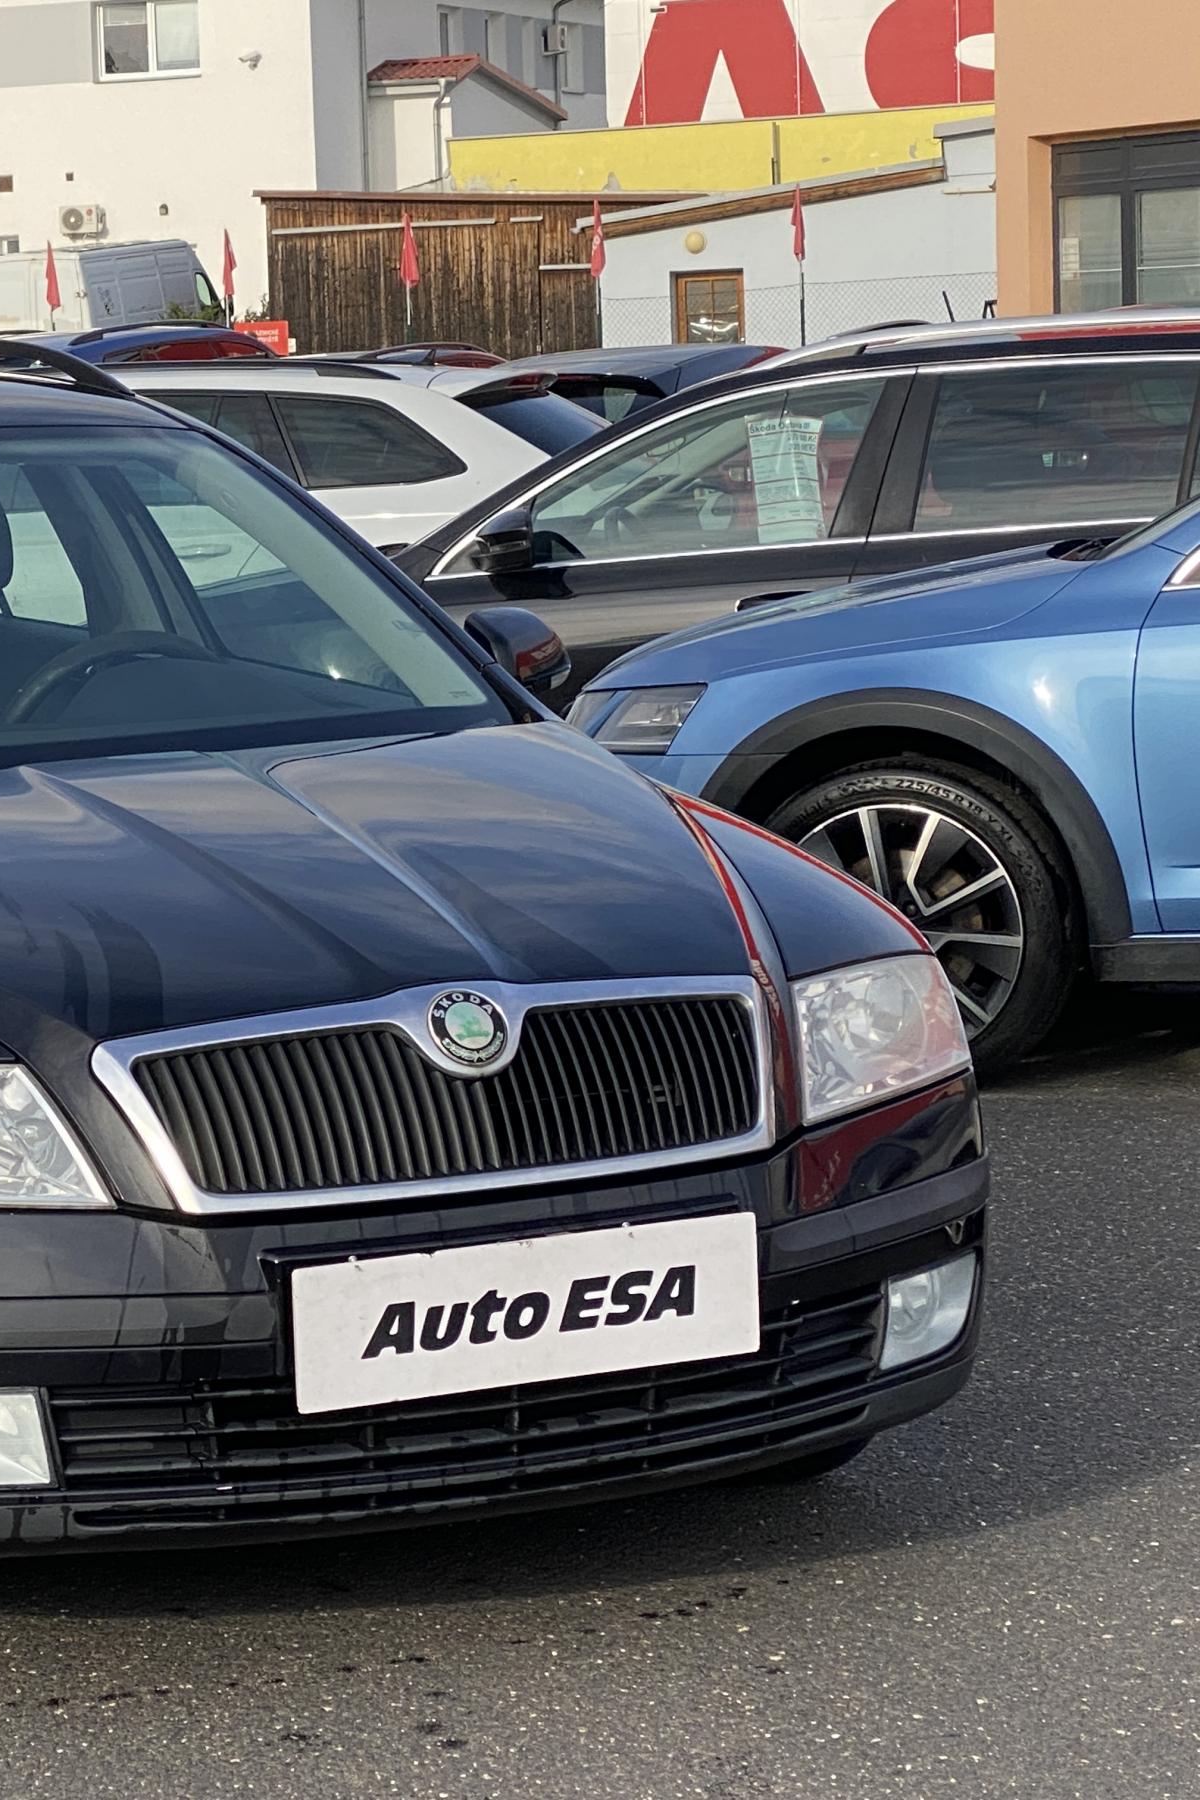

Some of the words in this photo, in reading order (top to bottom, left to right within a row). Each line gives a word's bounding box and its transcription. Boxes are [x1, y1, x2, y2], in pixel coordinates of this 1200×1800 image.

[896, 779, 951, 799] 225/45
[361, 1289, 550, 1359] Auto
[559, 1265, 695, 1332] ESA
